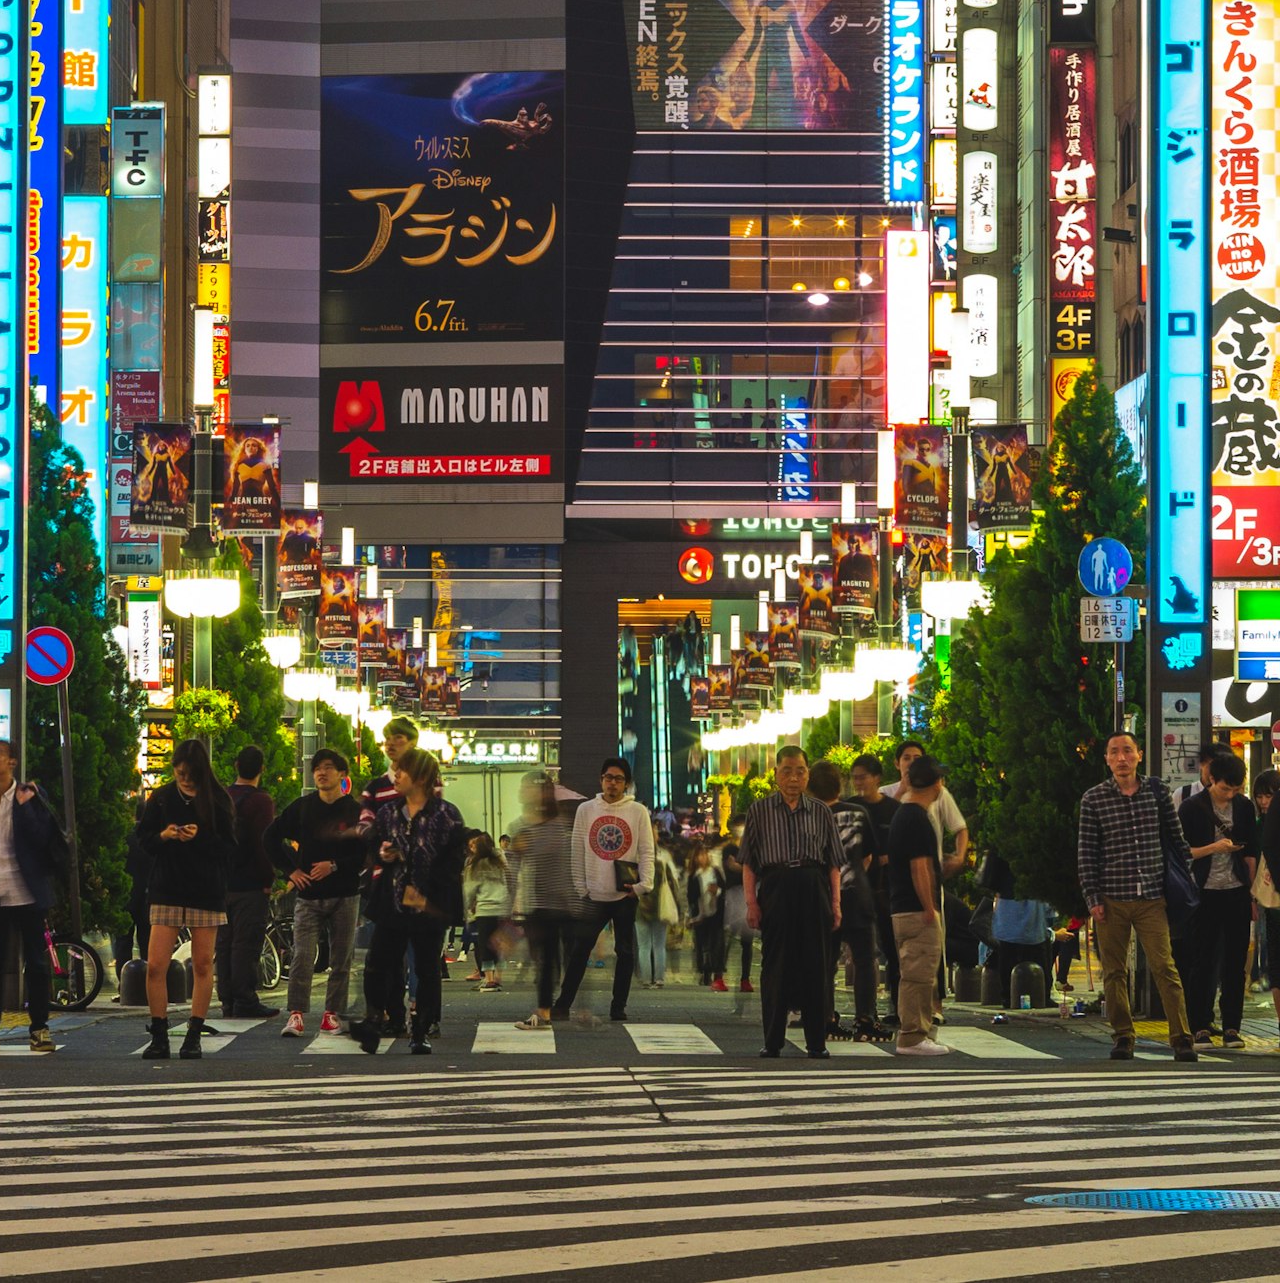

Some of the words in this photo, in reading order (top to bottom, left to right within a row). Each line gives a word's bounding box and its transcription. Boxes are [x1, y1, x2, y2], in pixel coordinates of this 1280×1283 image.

[1064, 54, 1082, 156] 手作り居酒屋
[1219, 0, 1260, 229] きんくら酒場
[124, 130, 150, 187] TFC
[327, 182, 557, 275] アラジン
[1051, 163, 1096, 286] 甘太郎
[1056, 304, 1092, 327] 4F
[1056, 329, 1092, 351] 3F
[400, 386, 550, 424] MARUHAN
[358, 453, 541, 475] 2F店舗出入口はビル左側
[232, 496, 251, 505] JEAN
[253, 496, 273, 505] GREY
[906, 494, 940, 505] CYCLOPS
[841, 580, 871, 588] MAGNETO
[458, 742, 540, 757] ACORN
